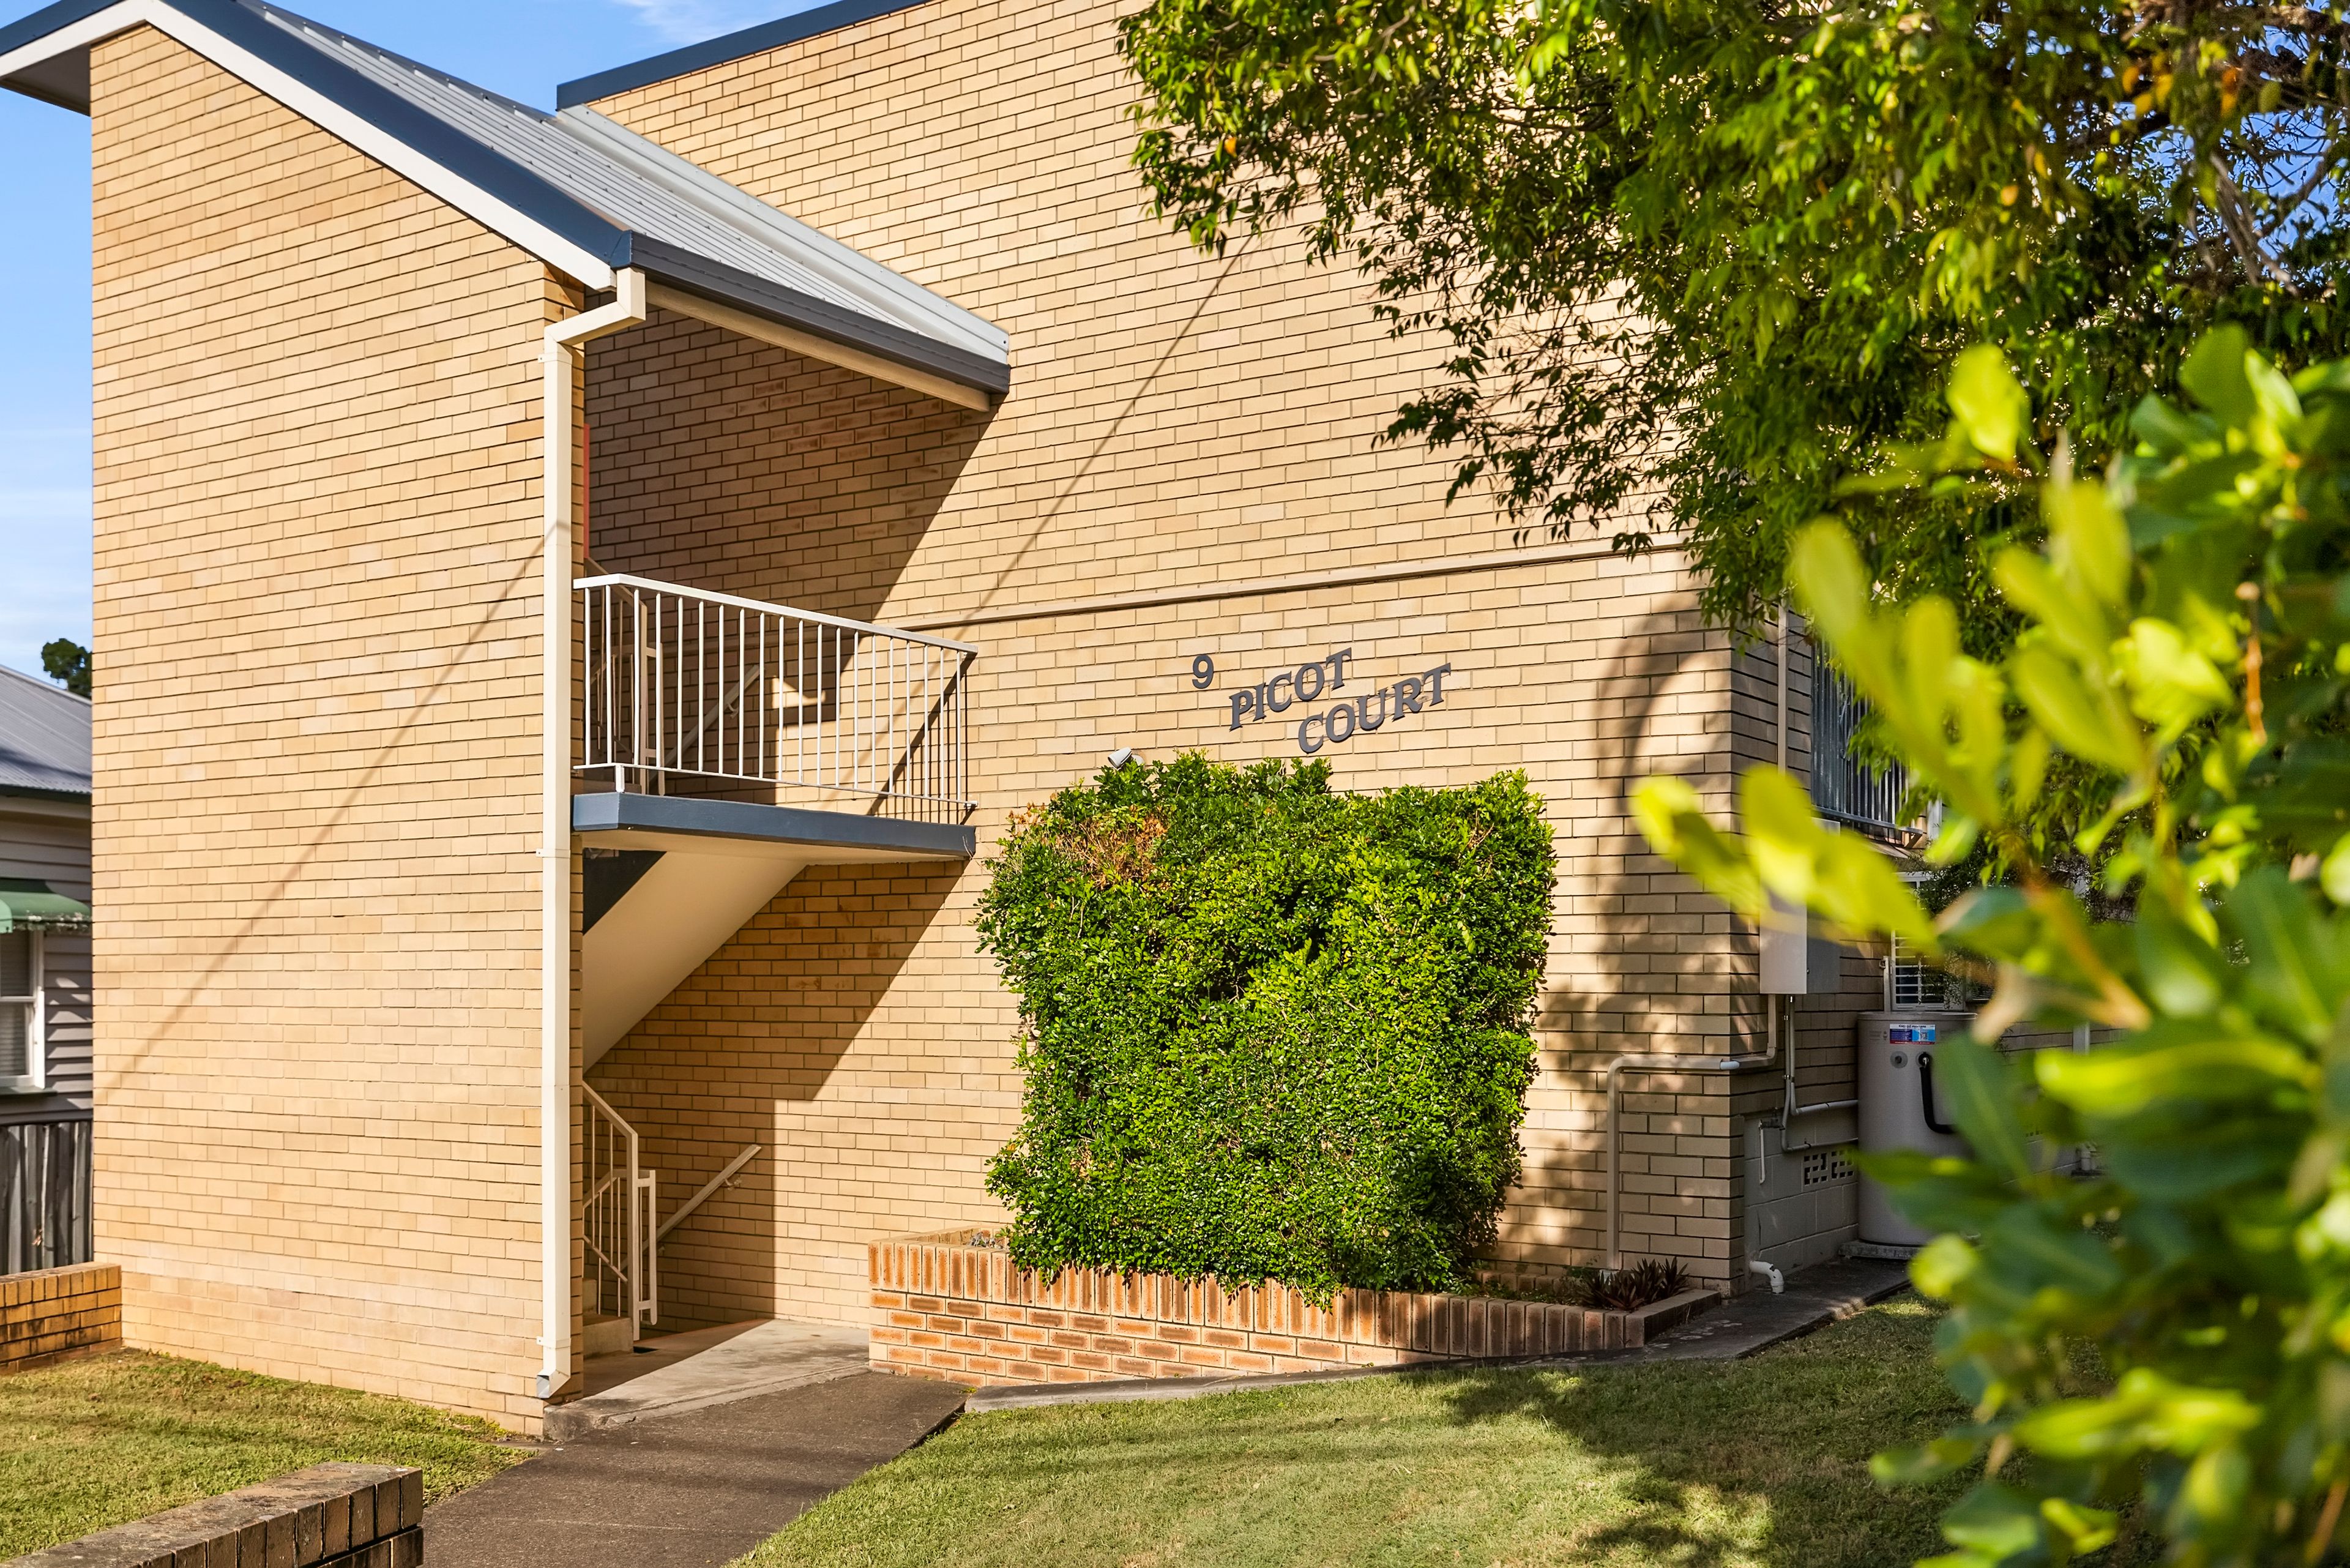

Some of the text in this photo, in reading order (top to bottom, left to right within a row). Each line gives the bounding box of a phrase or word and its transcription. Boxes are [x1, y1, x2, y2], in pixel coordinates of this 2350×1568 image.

[1192, 654, 1214, 689] 9
[1229, 647, 1352, 731] PICOT
[1299, 662, 1451, 753] COURT
